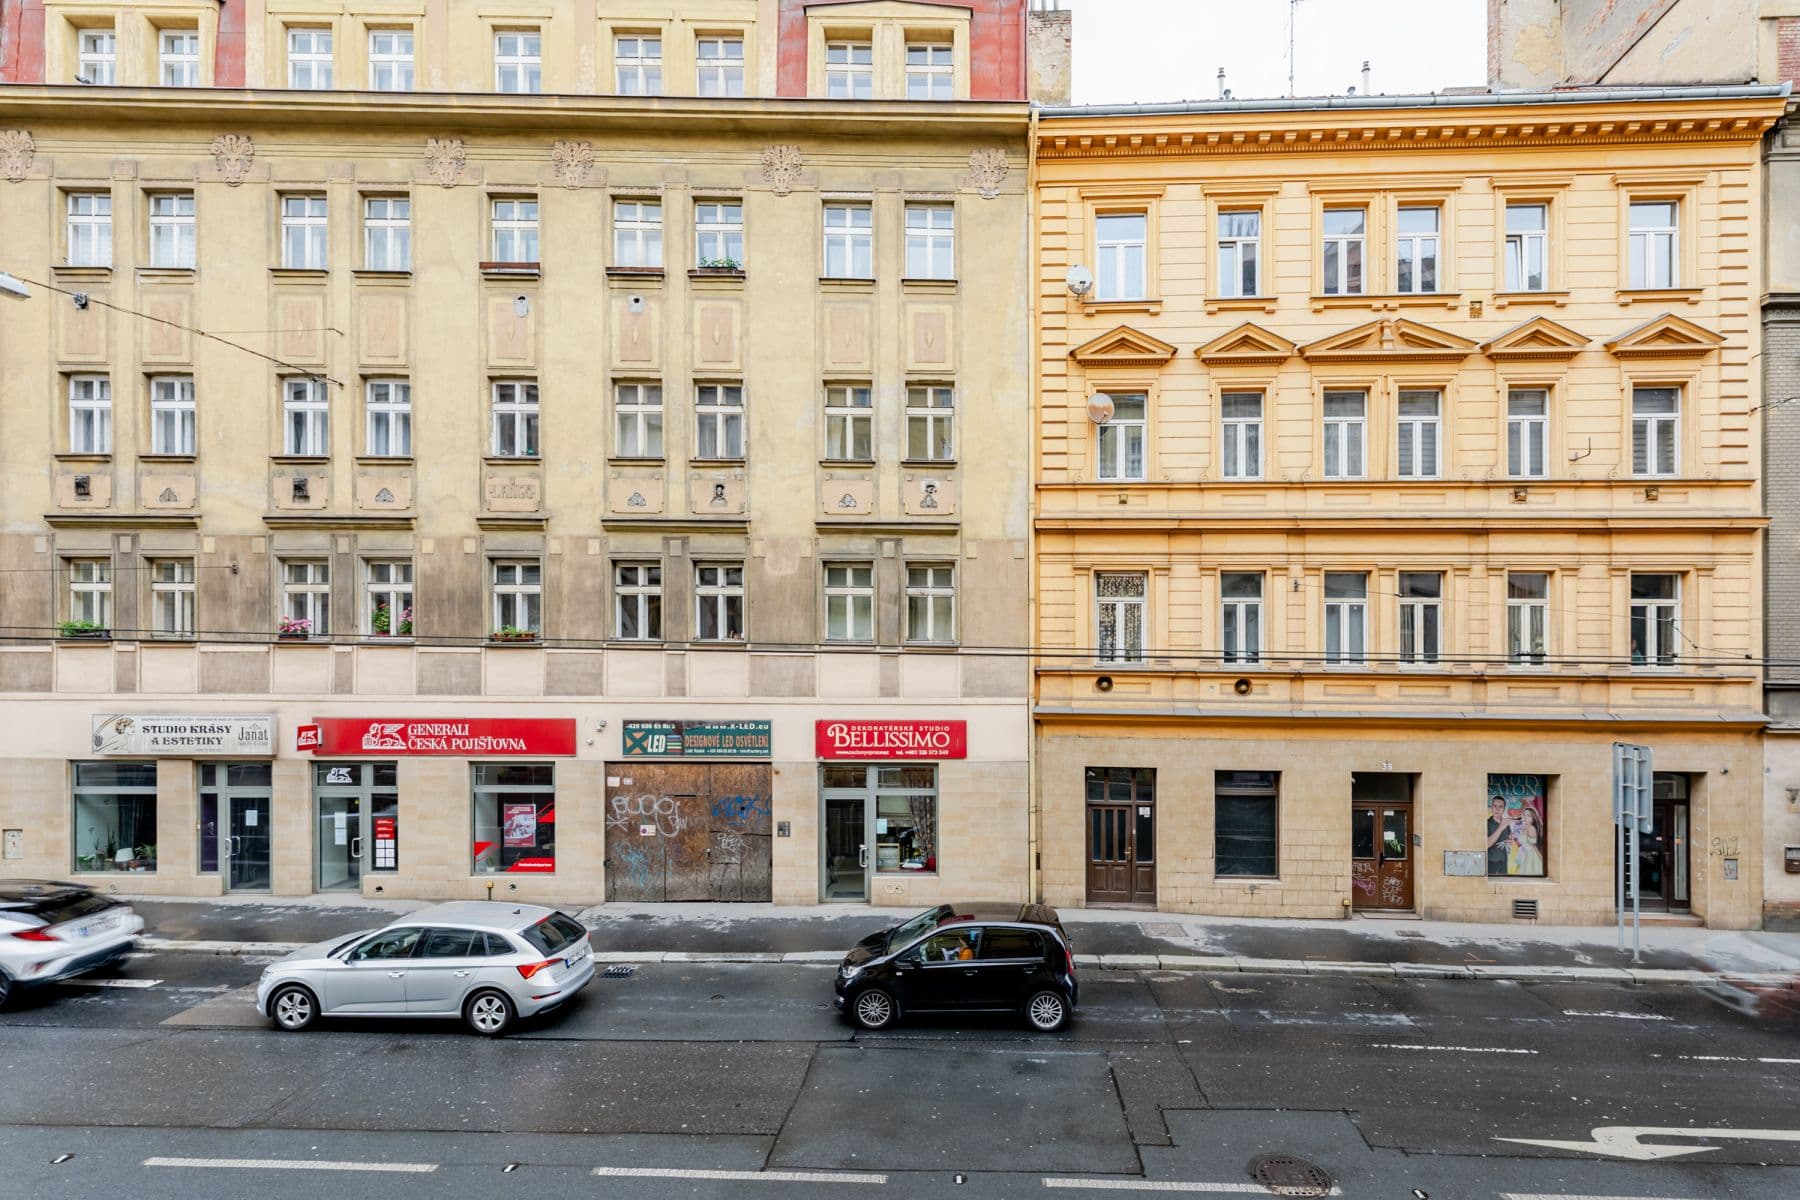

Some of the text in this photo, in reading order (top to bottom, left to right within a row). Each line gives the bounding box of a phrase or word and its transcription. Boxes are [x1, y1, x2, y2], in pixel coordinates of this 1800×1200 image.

[142, 723, 232, 734] STUDIO KRÁSY
[238, 726, 269, 741] Janat
[408, 723, 470, 735] GENERALI
[151, 736, 223, 745] A ESTETIKY
[408, 736, 527, 750] ČESKÁ POJIŠŤOVNA
[647, 734, 666, 753] LED
[684, 733, 720, 748] DESIGNOVÉ
[722, 735, 734, 748] LED
[1488, 775, 1540, 785] EAUTY
